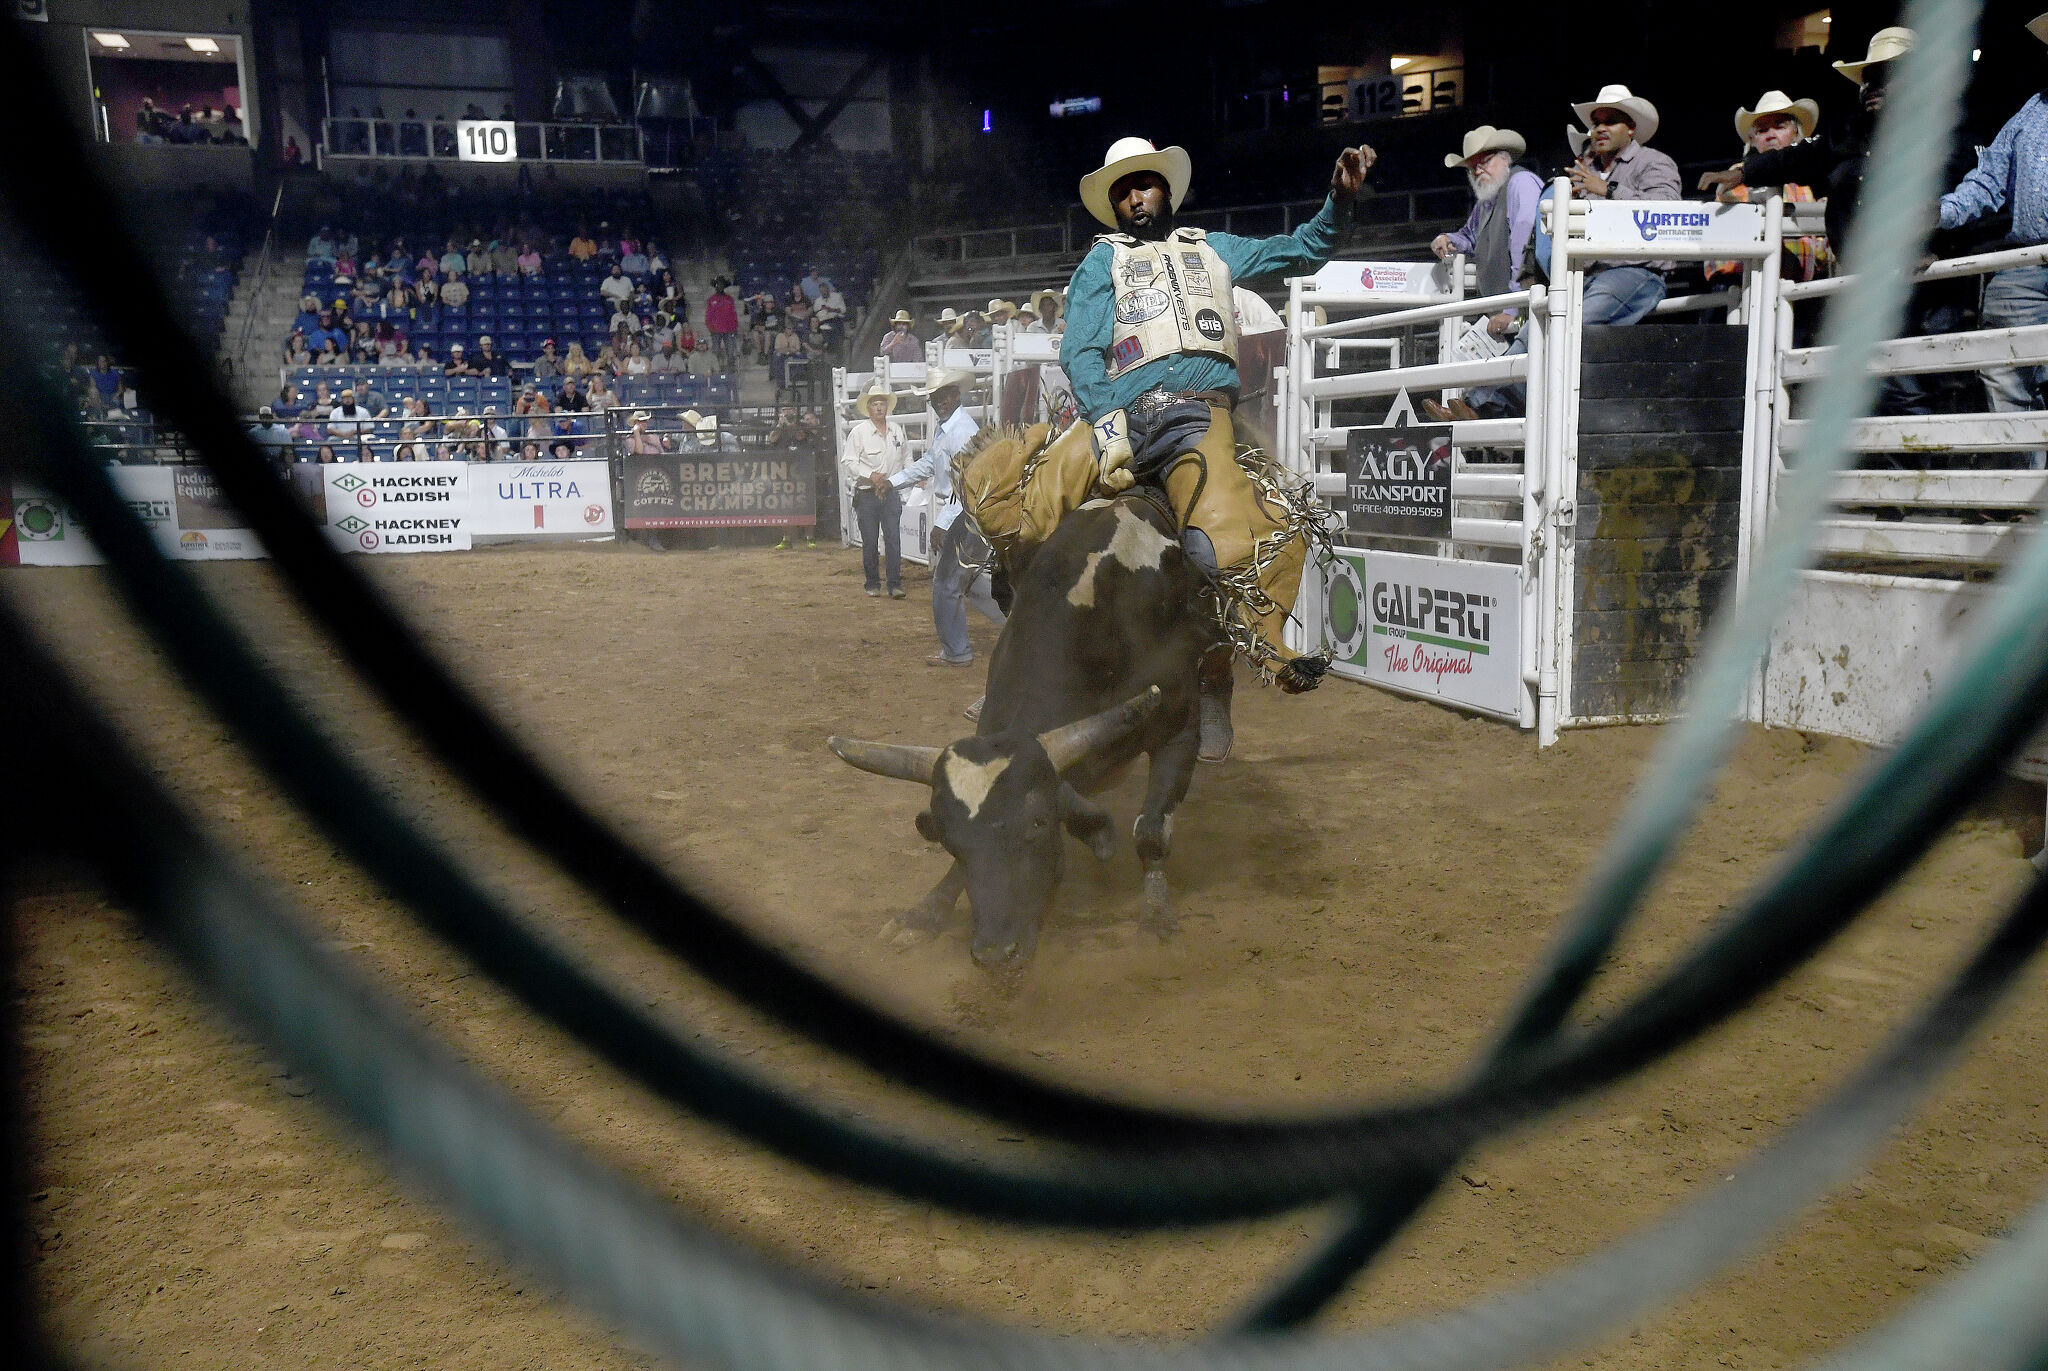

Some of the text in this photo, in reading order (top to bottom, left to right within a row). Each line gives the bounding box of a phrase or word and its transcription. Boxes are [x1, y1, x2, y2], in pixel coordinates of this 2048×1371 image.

[1355, 81, 1396, 114] 112
[466, 127, 508, 155] 110
[1632, 210, 1710, 229] VORTECH
[509, 465, 567, 479] Michelob
[1359, 451, 1434, 480] A.G.Y.
[372, 477, 458, 487] HACKNEY
[680, 481, 808, 496] GROUNDS FOR
[383, 492, 450, 502] LADISH
[499, 481, 581, 499] ULTRA
[1349, 484, 1447, 502] TRANSPORT
[633, 497, 674, 507] COFFEE
[680, 495, 808, 511] CHAMPIONS
[1352, 504, 1443, 517] OFFICE: 409-209-5059
[375, 519, 461, 530] HACKNEY
[385, 534, 452, 545] LADISH
[1388, 627, 1406, 638] GROUP
[1384, 643, 1473, 684] The Original
